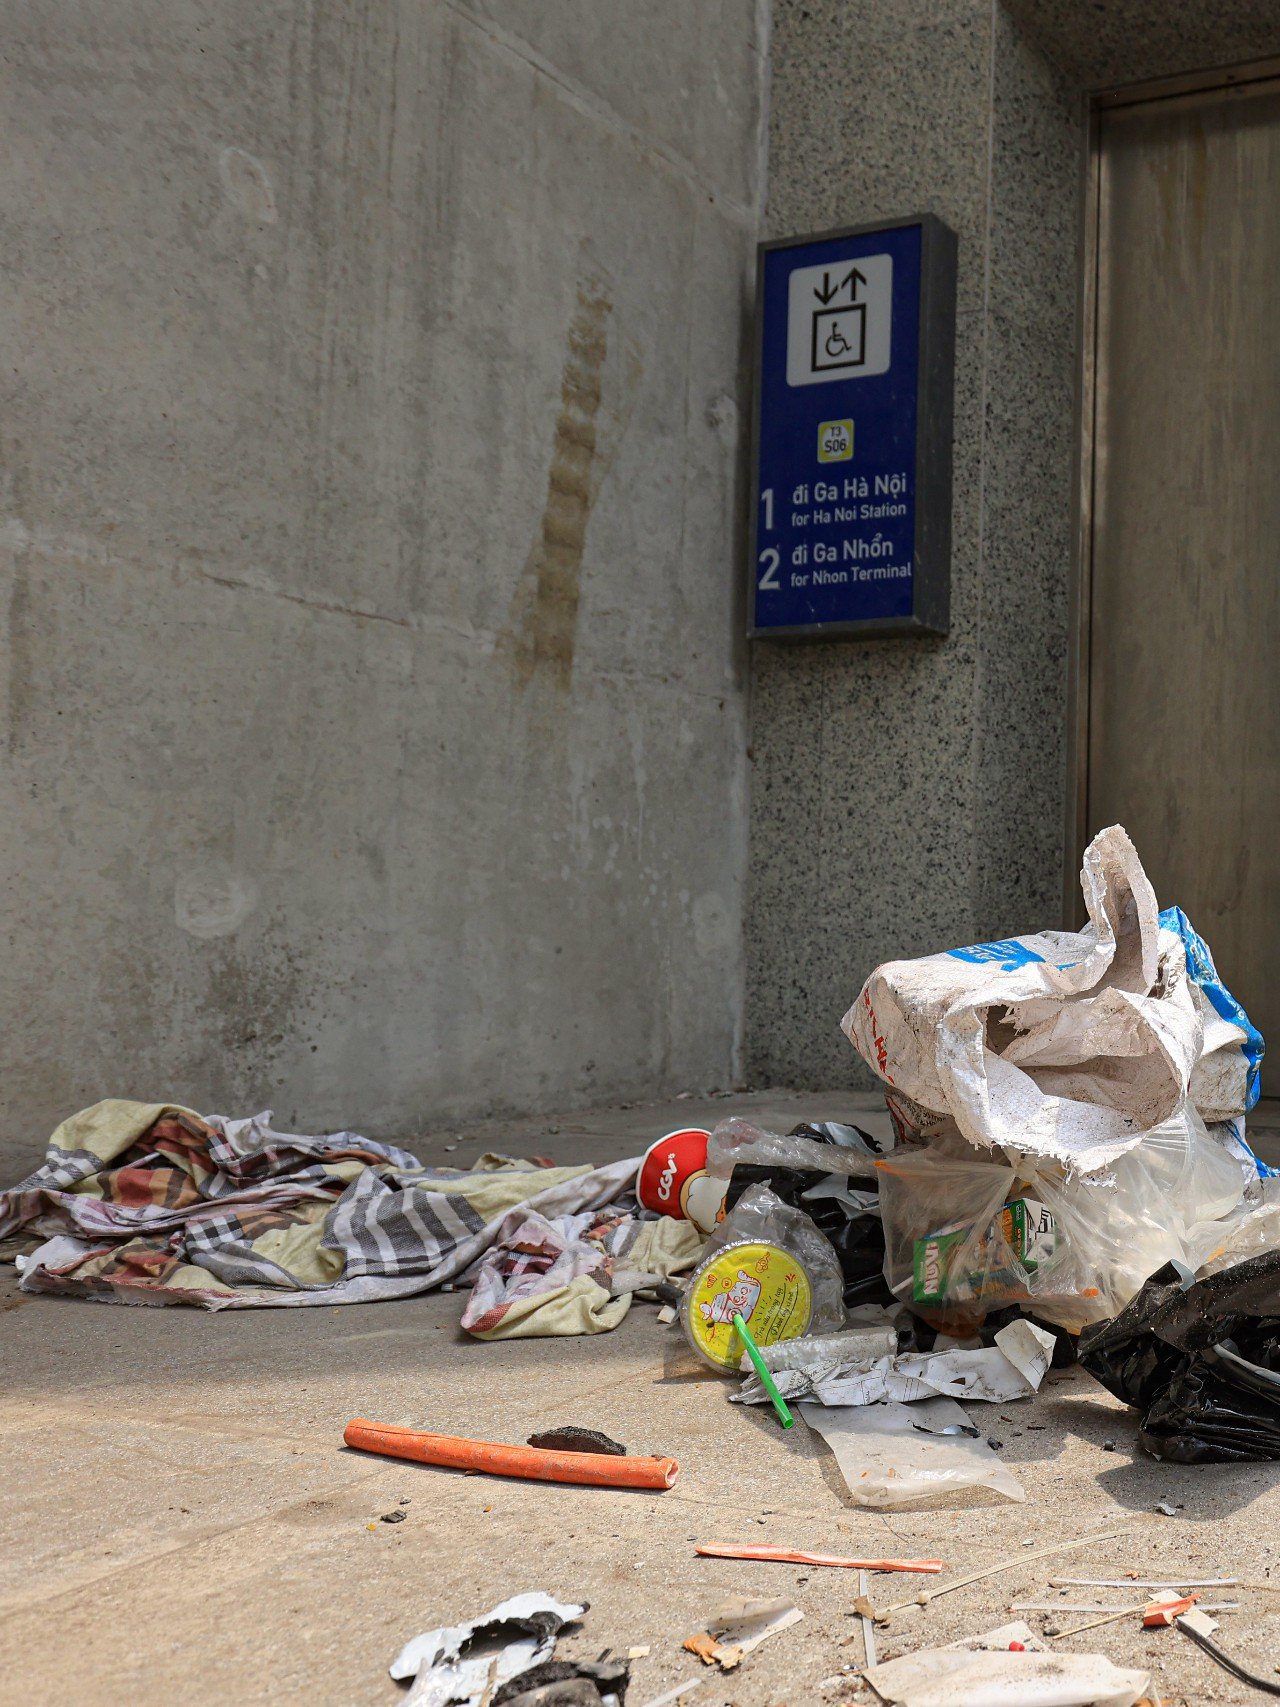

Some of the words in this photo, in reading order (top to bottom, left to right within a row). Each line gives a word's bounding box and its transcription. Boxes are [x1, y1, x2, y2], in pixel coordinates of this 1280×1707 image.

[824, 438, 847, 453] S06
[830, 426, 841, 437] T3
[792, 483, 809, 505] đi
[814, 481, 838, 502] Ga
[843, 476, 869, 499] Hà
[874, 472, 907, 499] Nội
[761, 488, 774, 530] 1
[792, 511, 810, 527] for
[813, 510, 831, 525] Ha
[834, 506, 857, 522] Noi
[860, 502, 907, 520] Station
[791, 544, 808, 565] đi
[813, 542, 838, 563] Ga
[843, 532, 894, 561] Nhổn
[758, 547, 781, 591] 2
[790, 572, 809, 587] for
[812, 570, 848, 586] Nhon
[851, 562, 912, 582] Terminal
[657, 1159, 678, 1201] CGV
